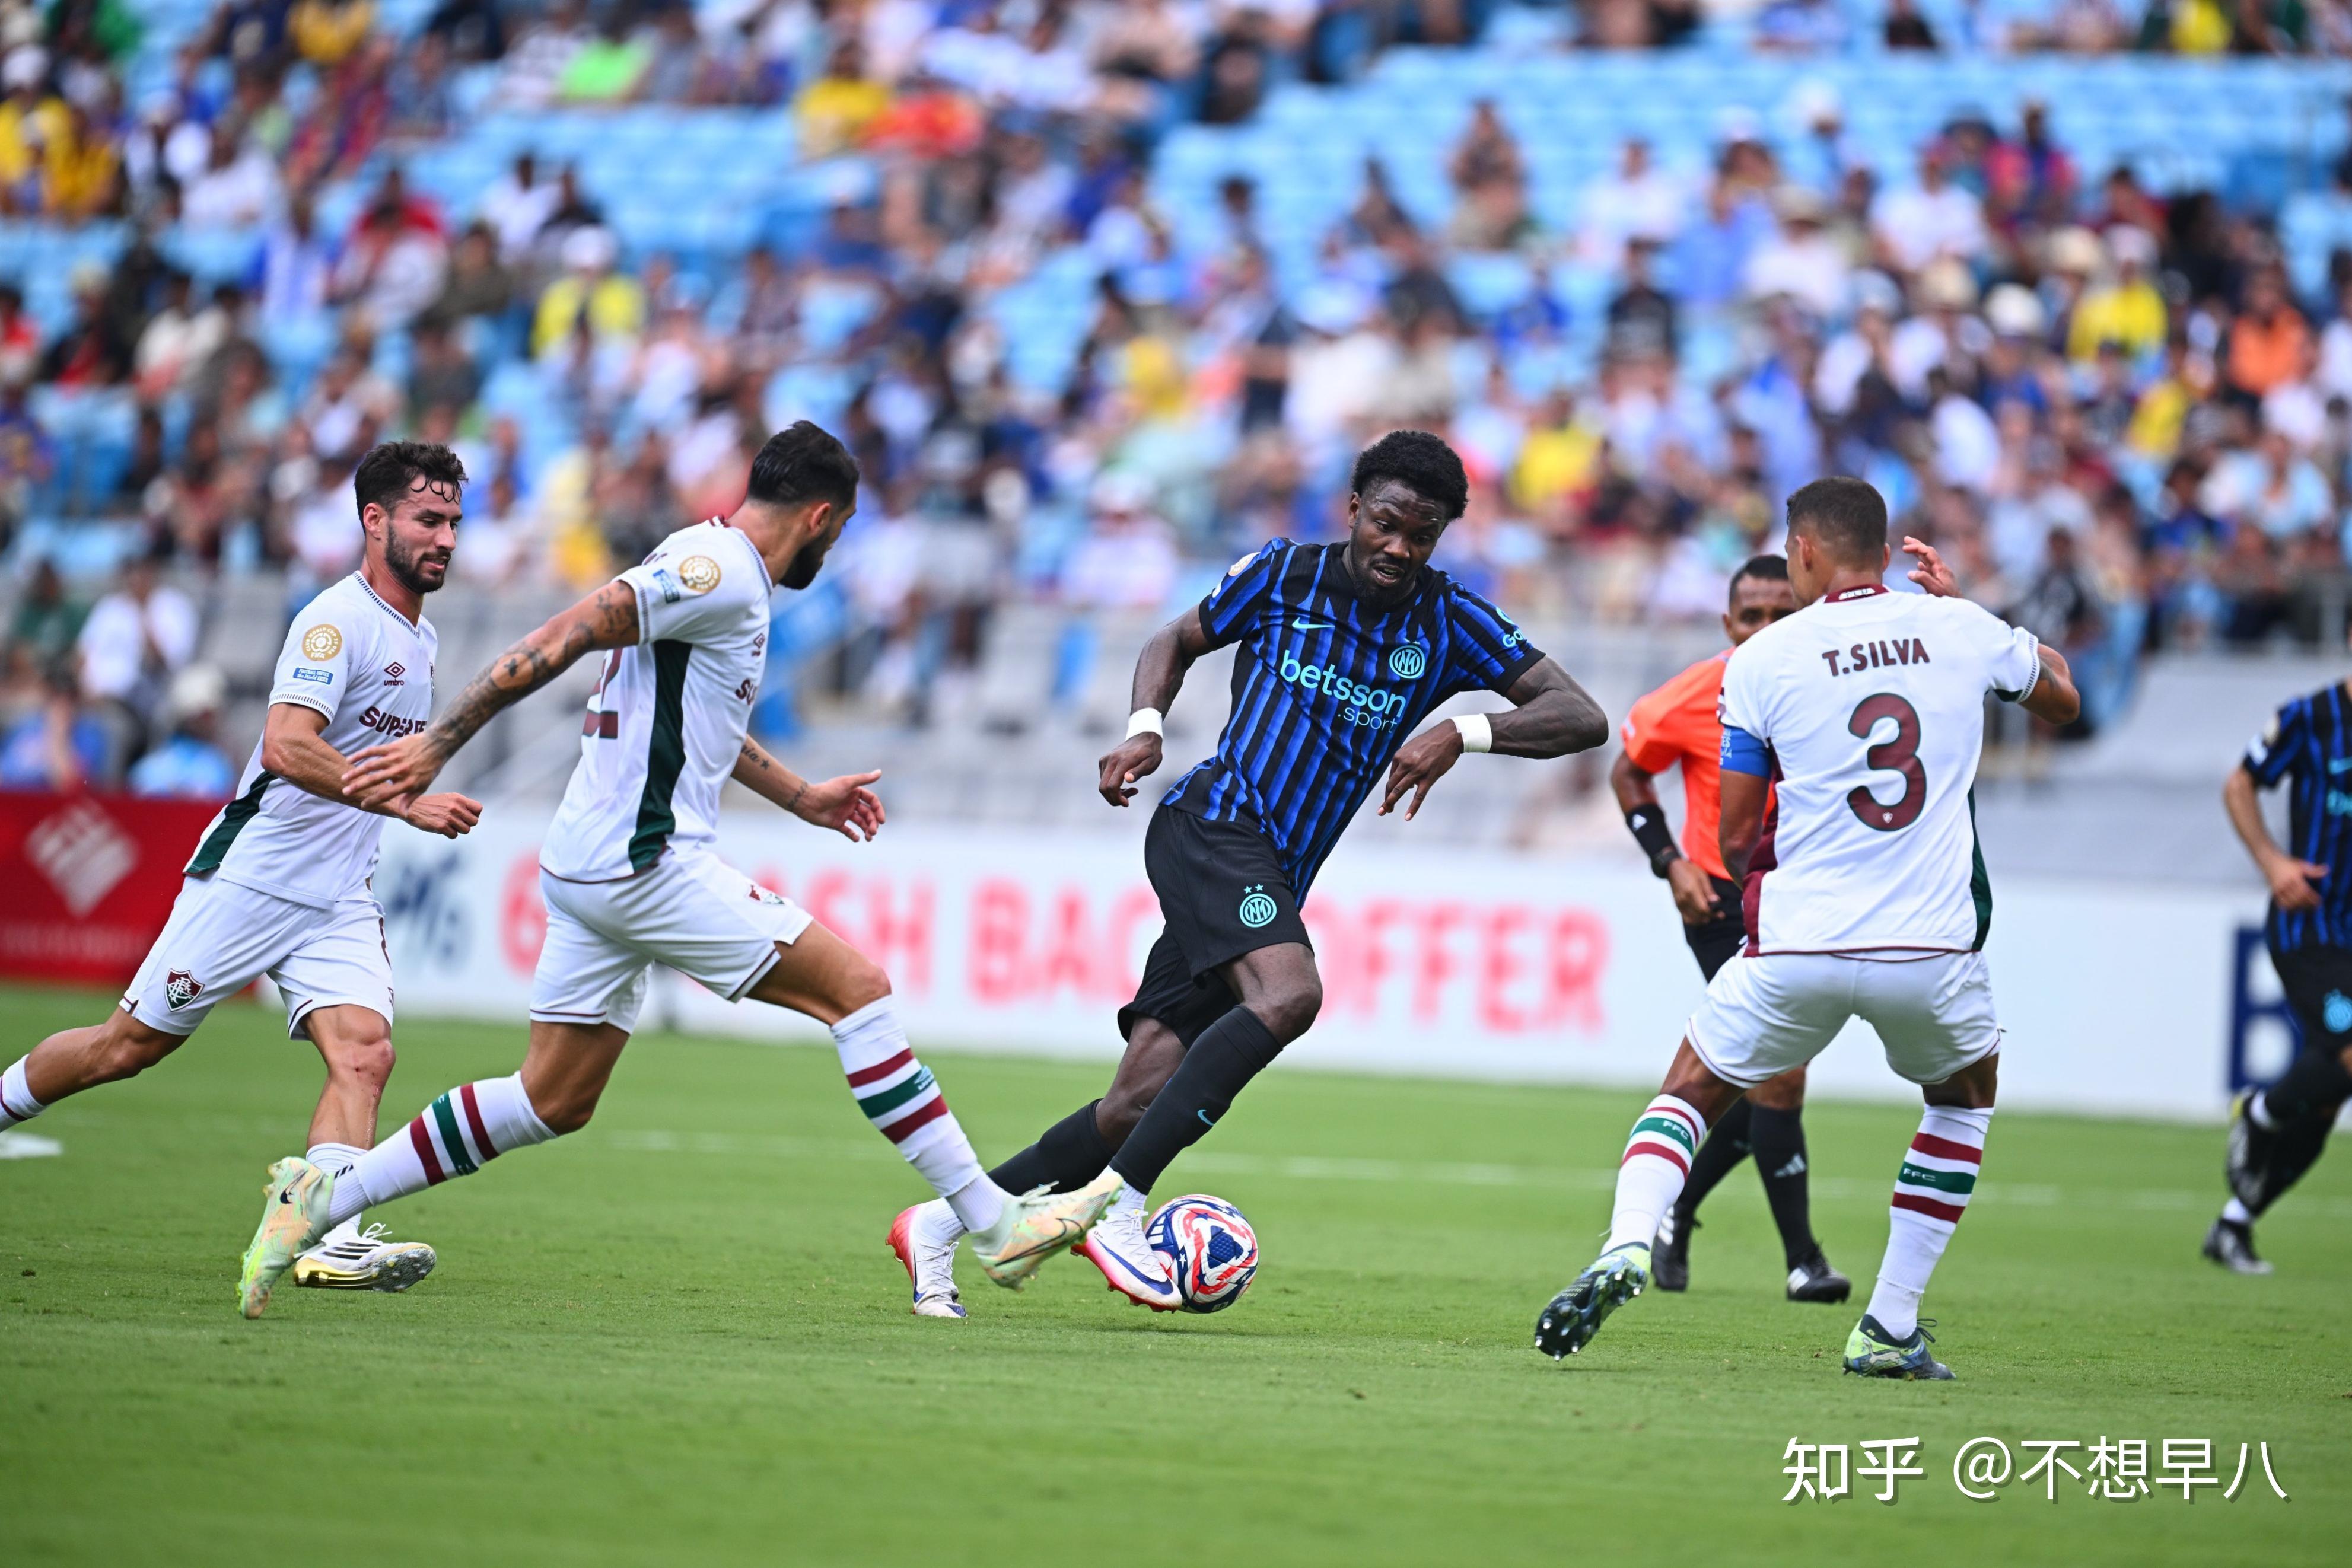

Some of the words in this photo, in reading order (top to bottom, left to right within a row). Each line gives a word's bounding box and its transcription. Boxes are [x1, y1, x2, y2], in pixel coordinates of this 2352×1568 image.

[1822, 638, 1930, 677] T.SILVA
[1280, 649, 1407, 718] betsson
[1338, 707, 1398, 734] .sport
[1847, 692, 1927, 831] 3
[1663, 1120, 1690, 1140] FFC
[1903, 1168, 1936, 1182] FFC
